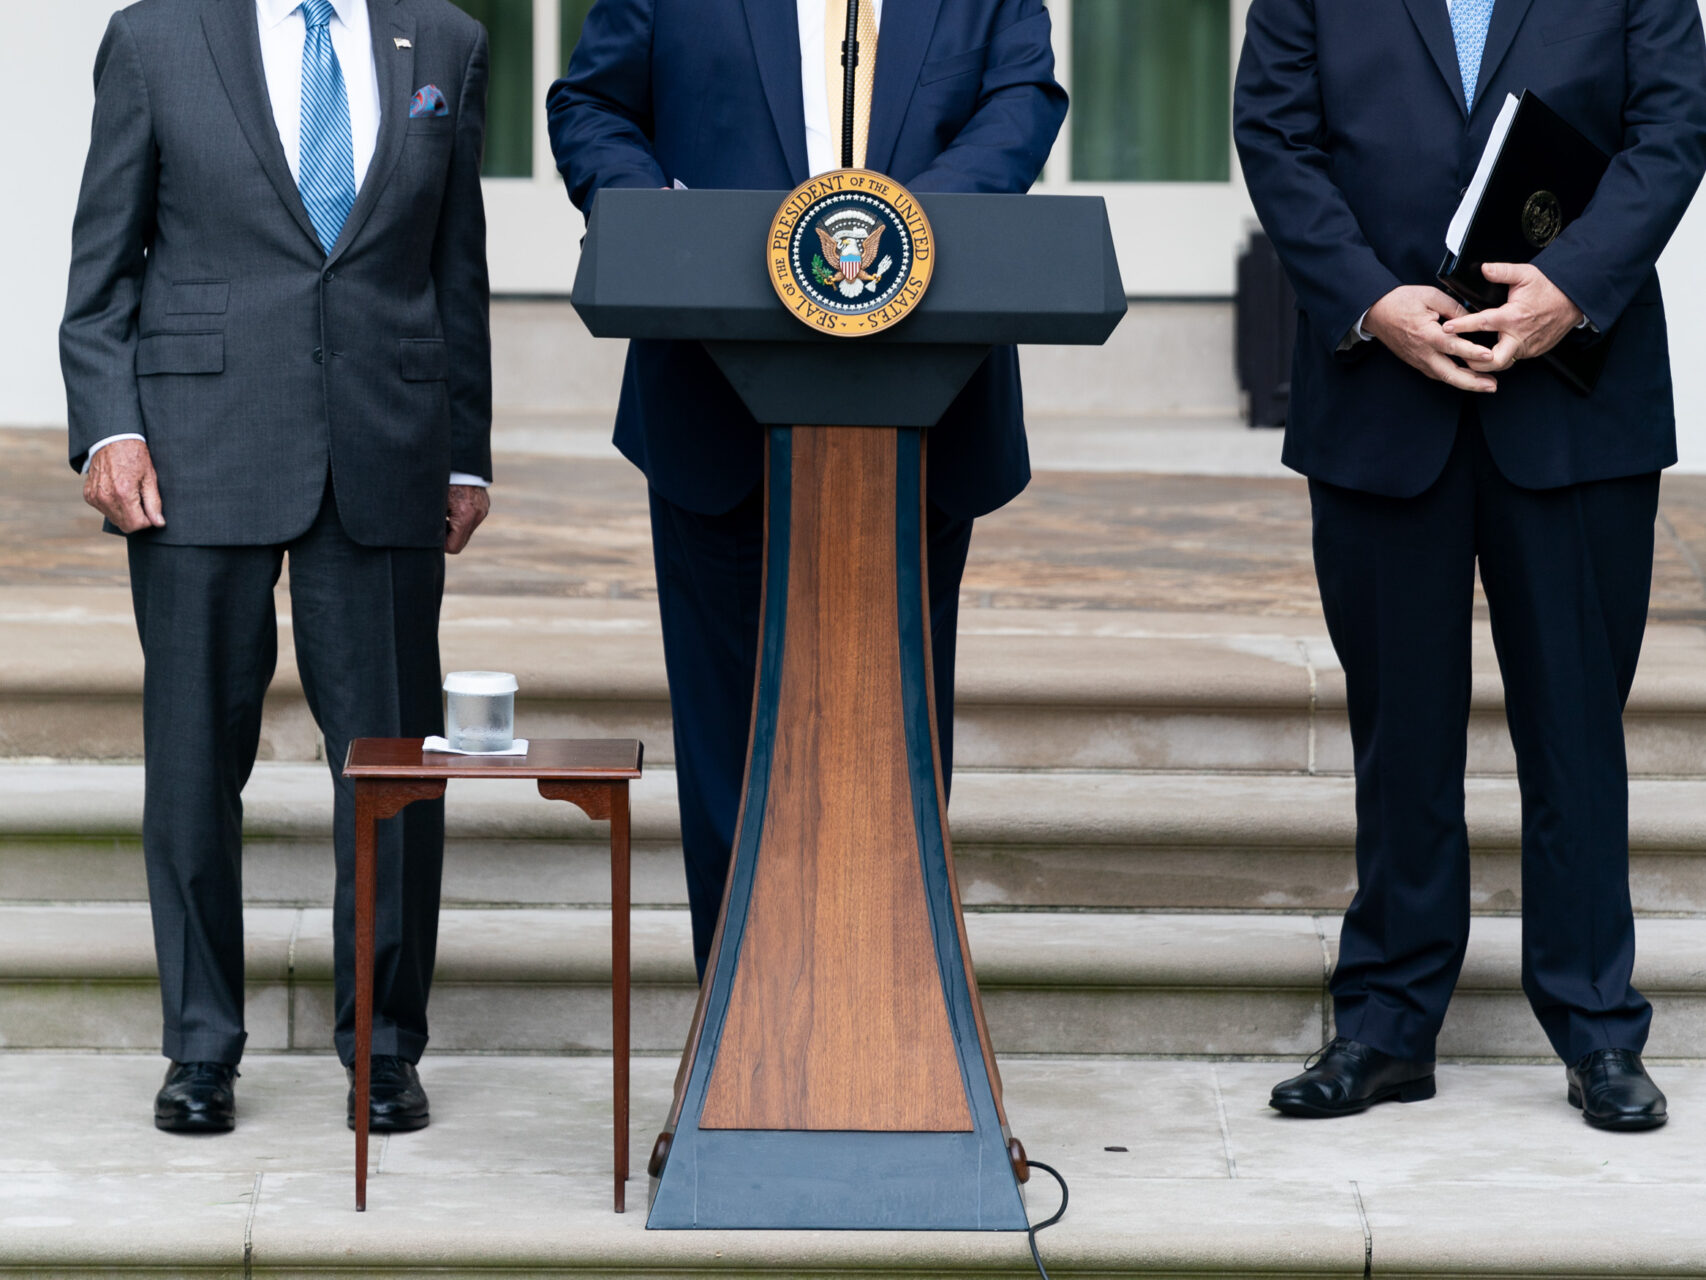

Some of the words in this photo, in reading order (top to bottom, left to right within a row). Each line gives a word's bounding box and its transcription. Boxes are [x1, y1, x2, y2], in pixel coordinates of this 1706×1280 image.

[849, 176, 865, 188] OF
[868, 179, 890, 196] THE
[773, 175, 844, 251] PRESIDENT
[894, 193, 930, 261] UNITED
[775, 257, 788, 280] THE
[782, 280, 796, 296] OF
[867, 276, 923, 328] STATES
[794, 294, 838, 329] SEAL
